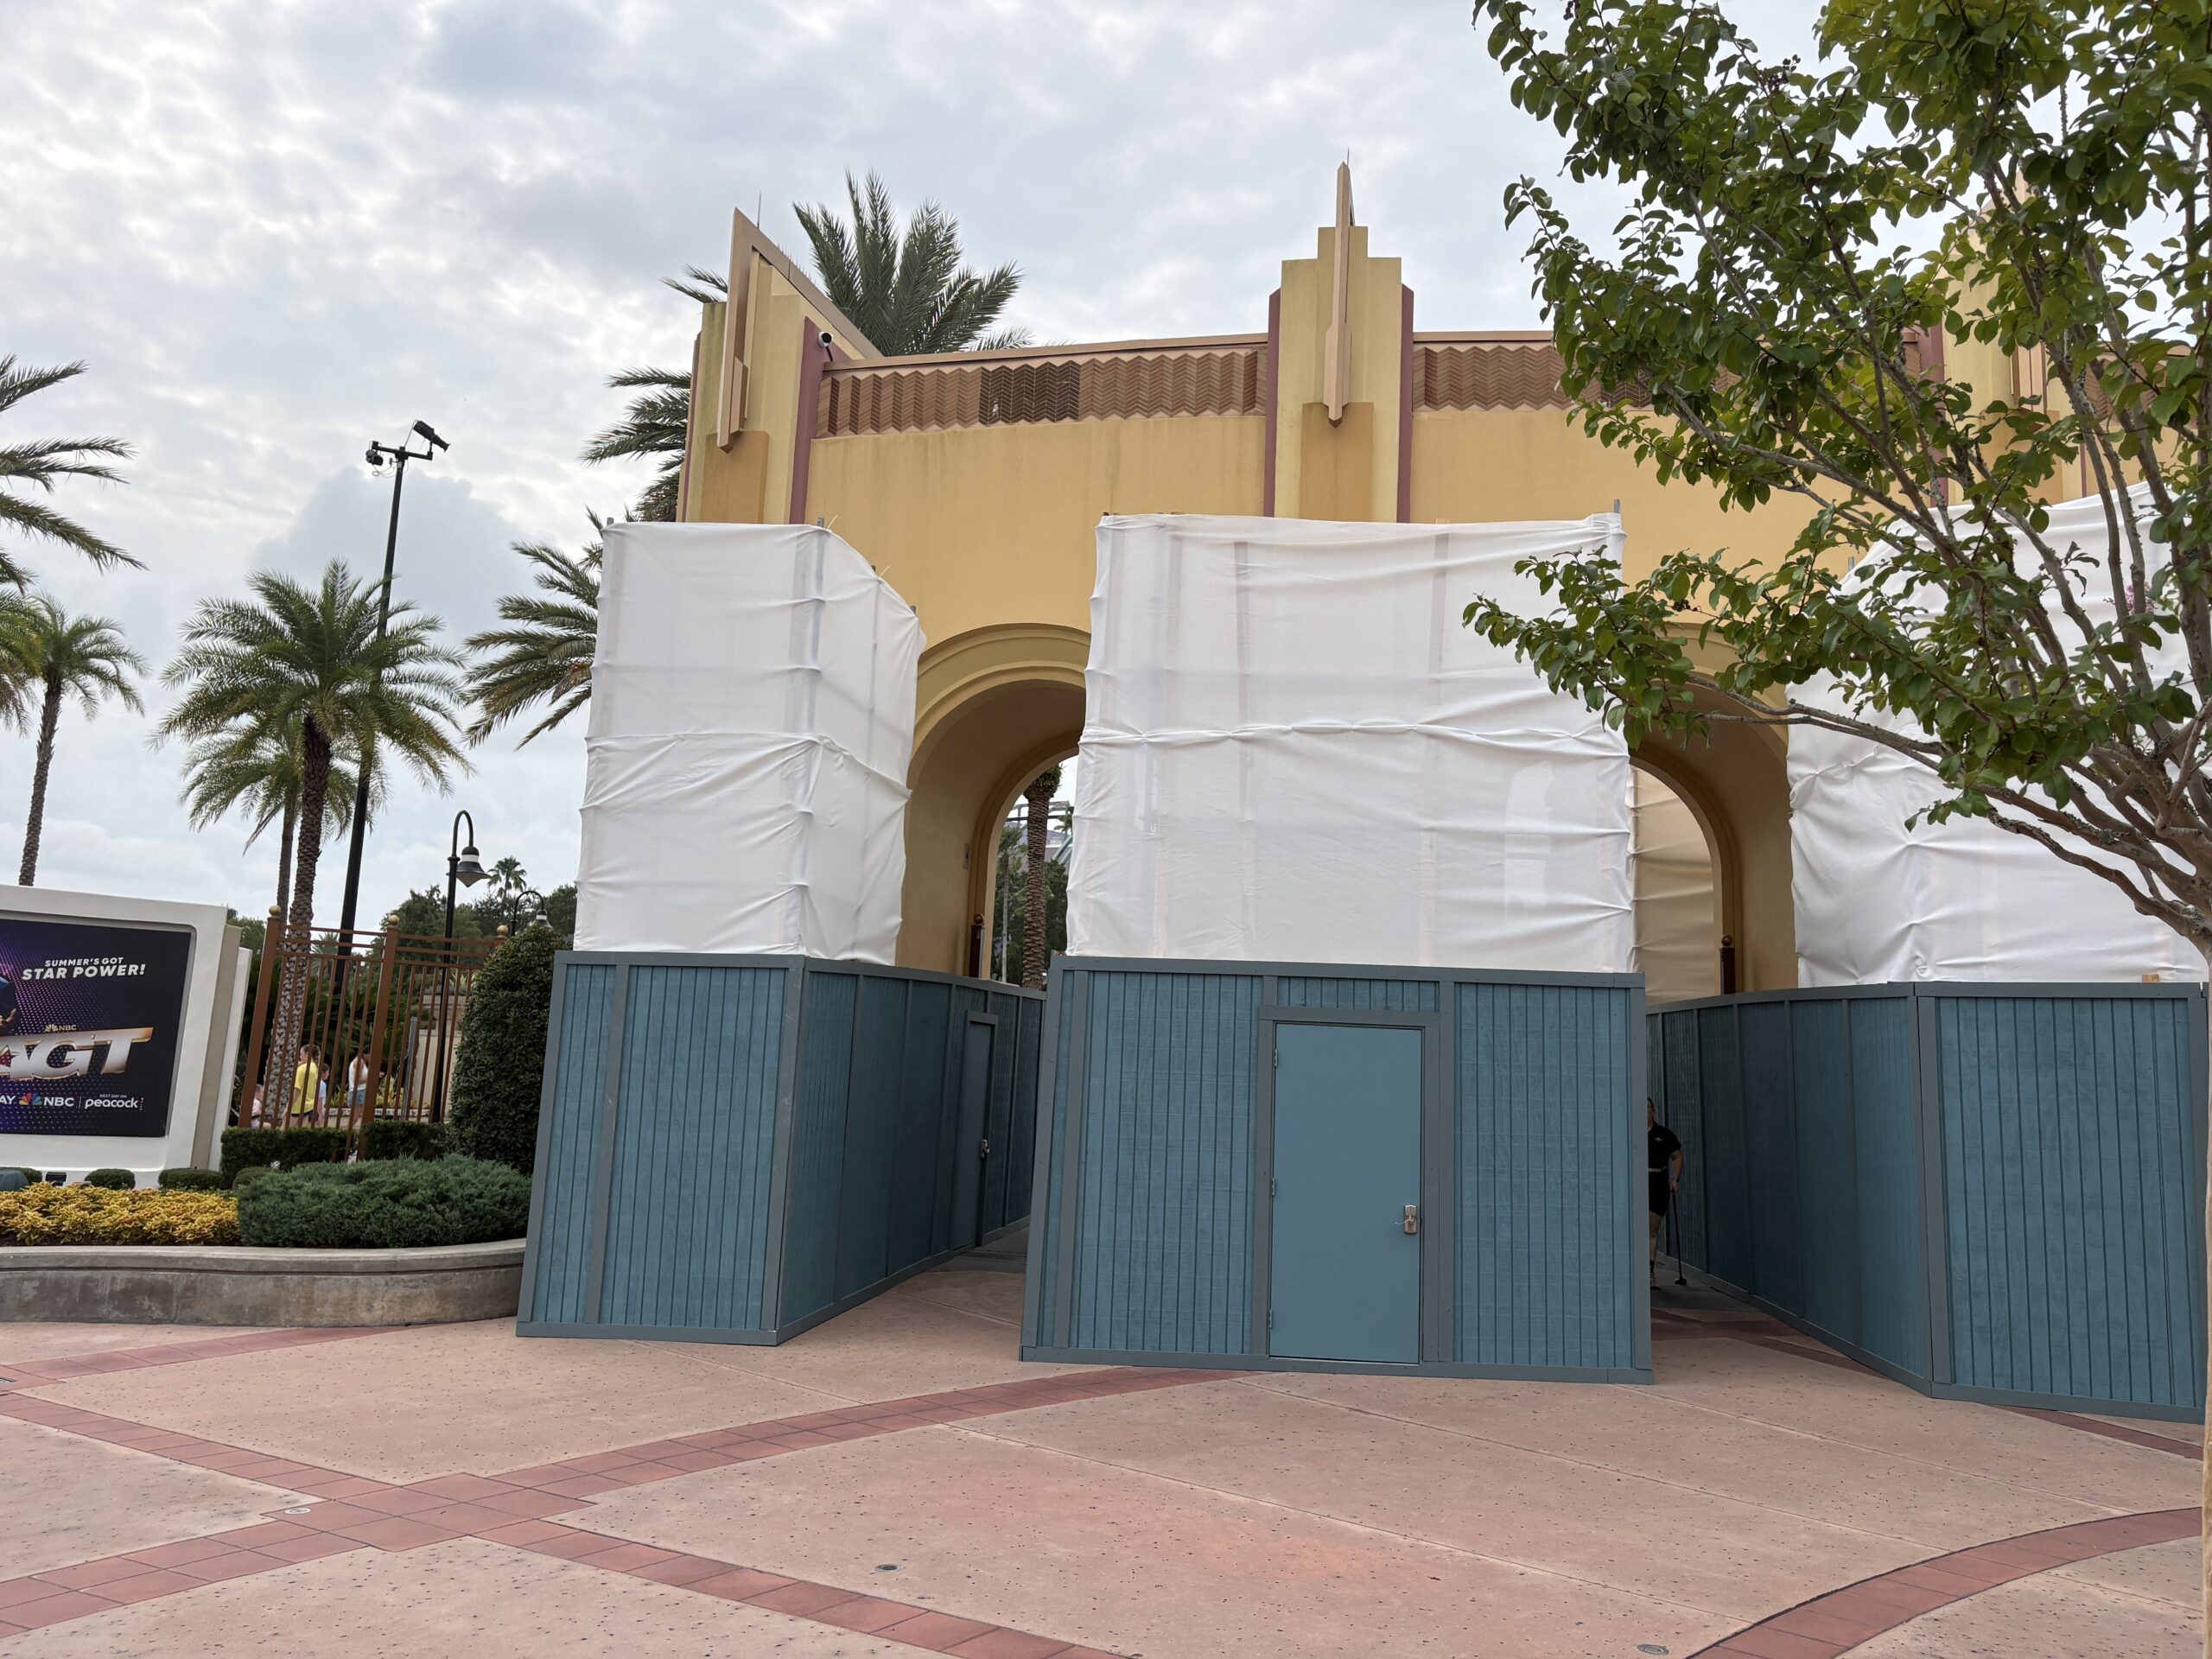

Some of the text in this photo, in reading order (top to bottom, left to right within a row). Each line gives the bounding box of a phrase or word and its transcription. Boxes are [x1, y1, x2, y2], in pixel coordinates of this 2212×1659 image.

[45, 957, 124, 967] SUMMER'S GOT
[22, 963, 146, 980] STAR POWER!
[43, 1096, 75, 1107] NBC
[85, 1096, 139, 1109] peacock
